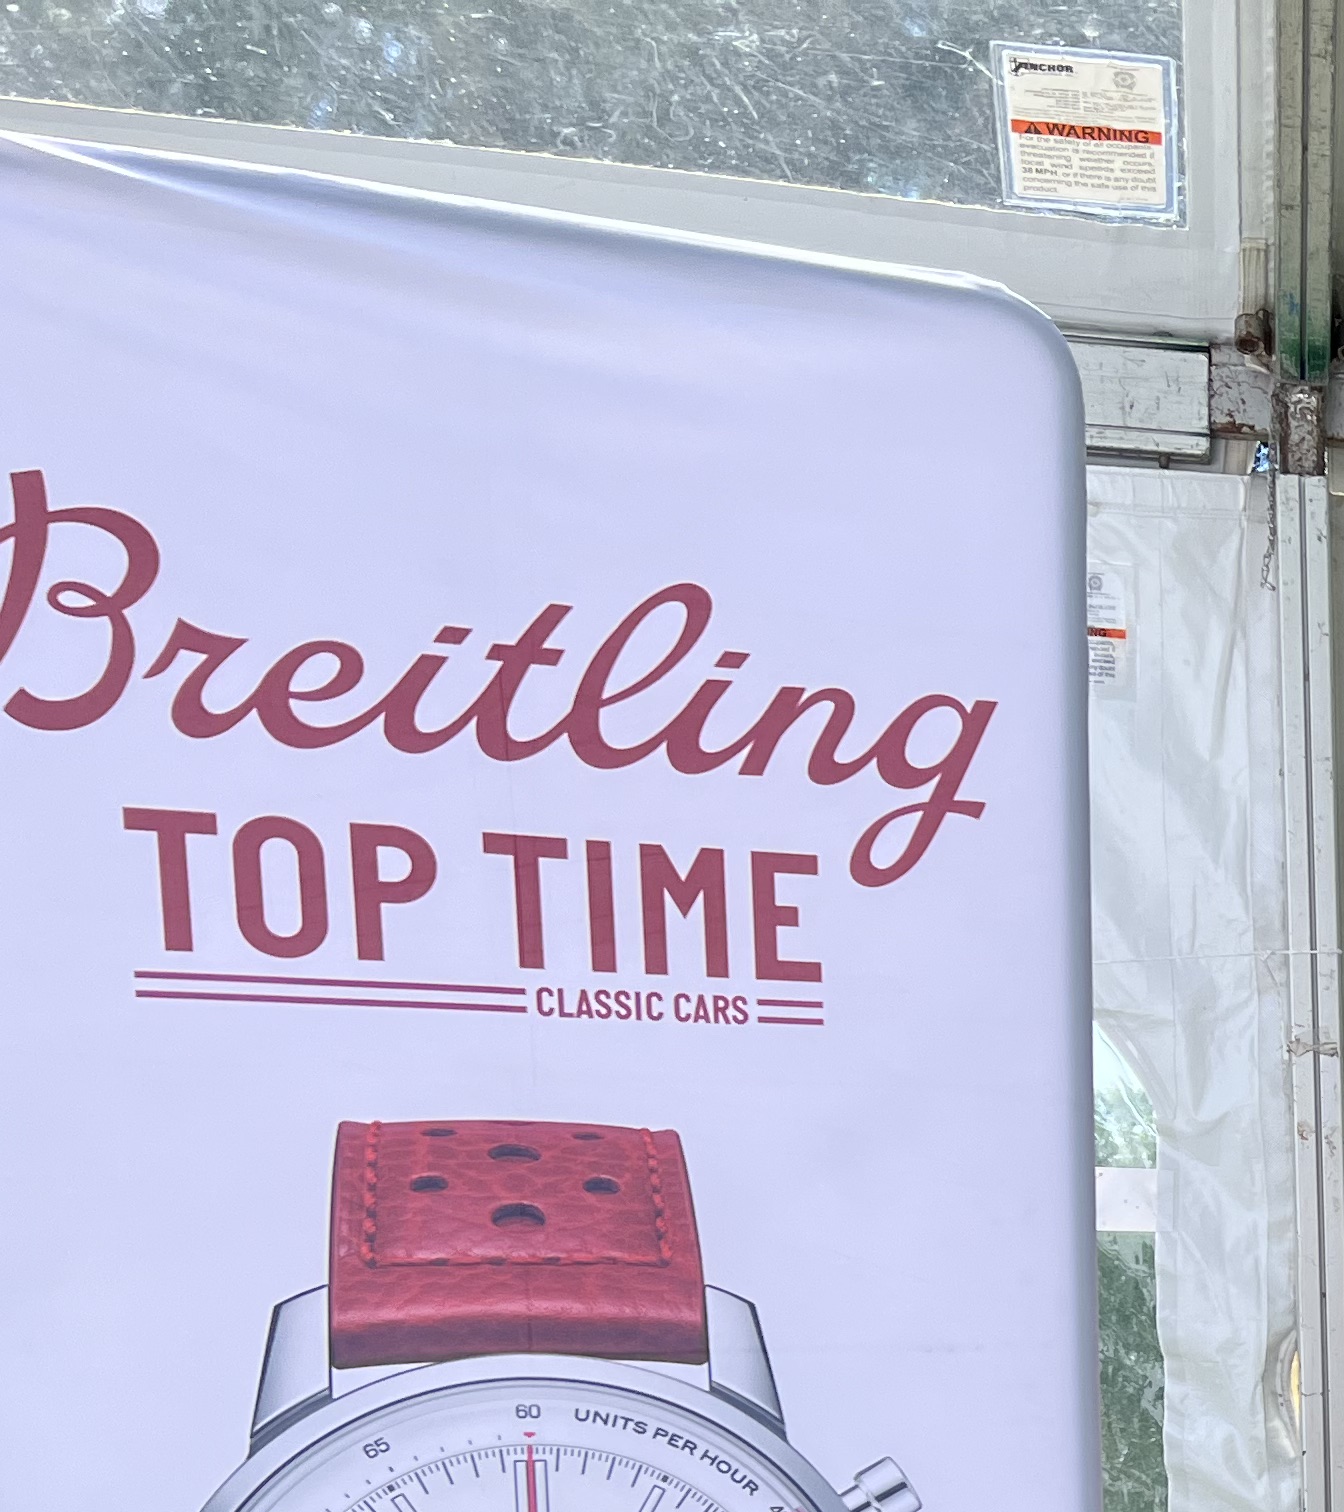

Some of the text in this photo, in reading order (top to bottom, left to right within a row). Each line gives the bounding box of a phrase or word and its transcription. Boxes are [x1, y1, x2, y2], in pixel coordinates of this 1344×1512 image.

[1046, 123, 1149, 143] WARNING
[1053, 138, 1080, 147] safety
[1020, 143, 1069, 152] evacuation
[1082, 149, 1147, 158] recommended
[1020, 150, 1071, 162] threatening
[1079, 165, 1114, 173] speeds
[0, 469, 998, 887] Breitling
[123, 806, 822, 983] TOP TIME
[536, 987, 749, 1025] CLASSIC CARS
[515, 1404, 541, 1419] 60
[363, 1437, 391, 1459] 65
[574, 1408, 759, 1496] UNITS PER HOUR
